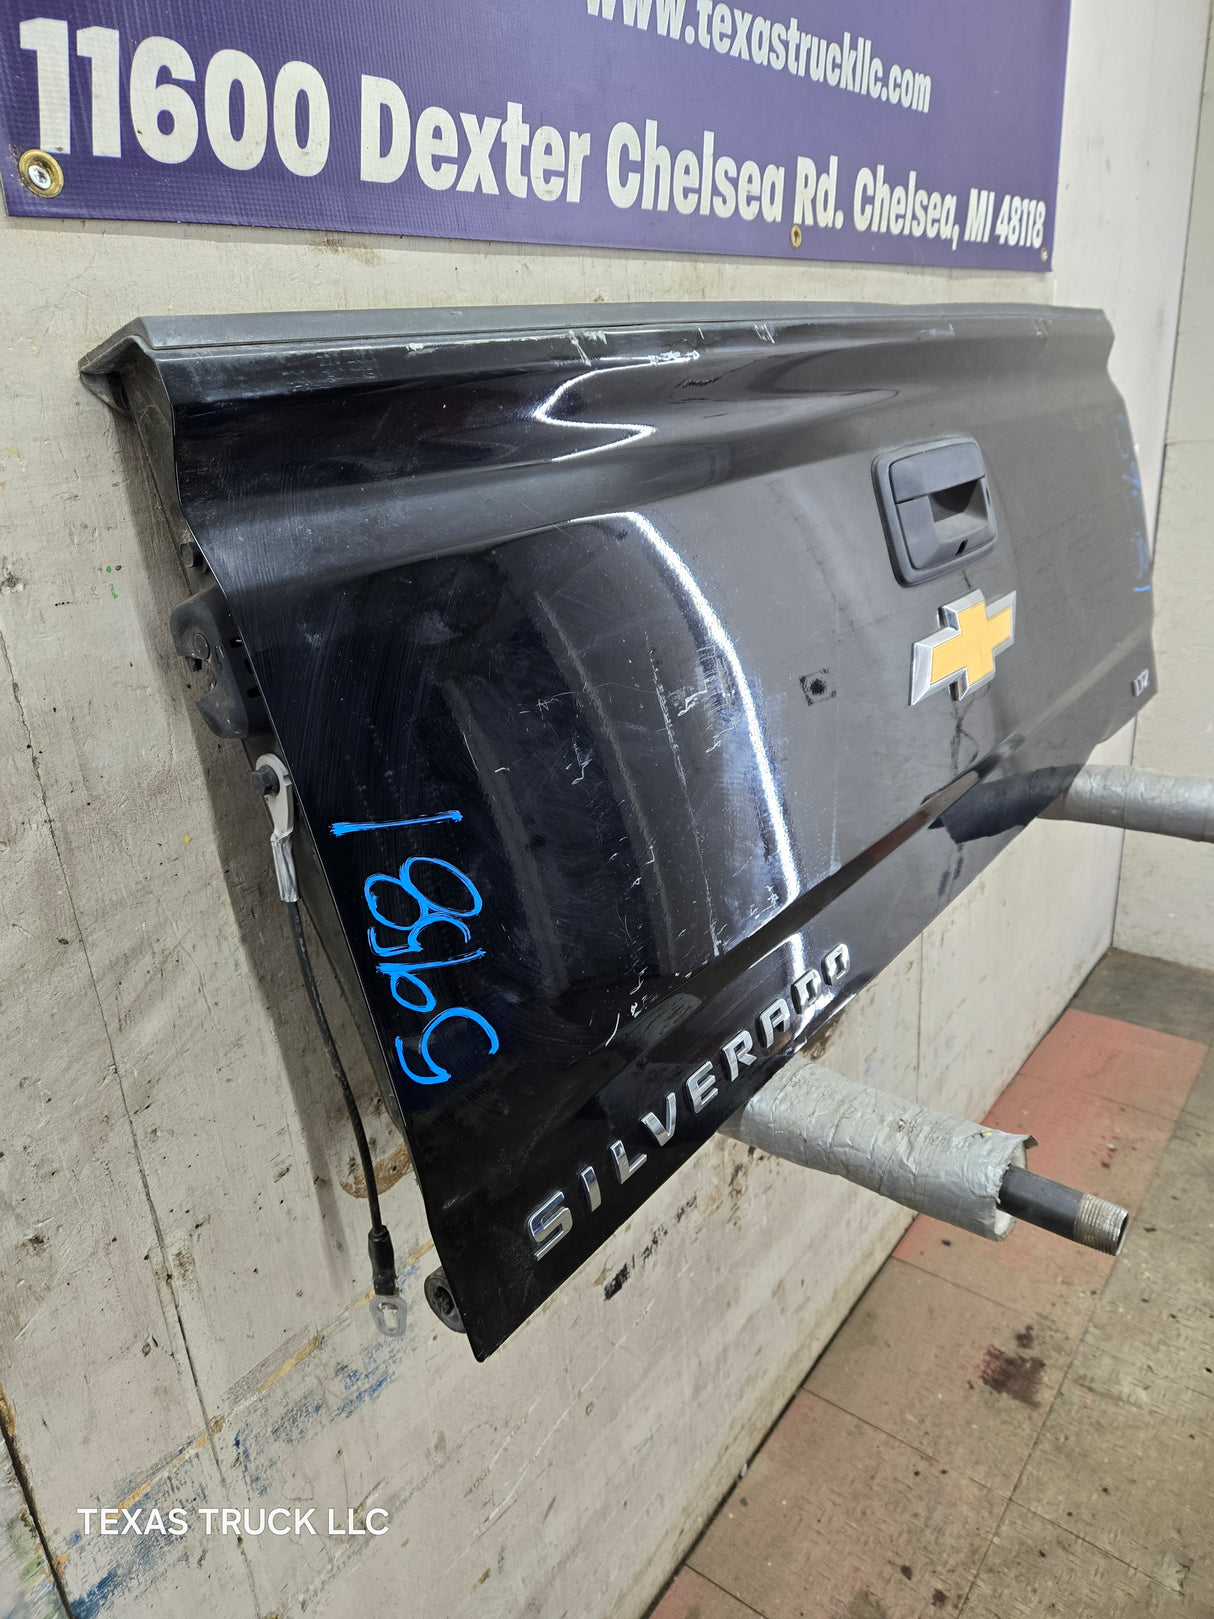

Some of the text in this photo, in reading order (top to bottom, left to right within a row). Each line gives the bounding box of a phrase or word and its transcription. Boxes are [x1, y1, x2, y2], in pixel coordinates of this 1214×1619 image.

[19, 17, 1047, 250] 11600 Dexter Chelsea Rd. Chelsea, MI 48118
[527, 943, 851, 1262] SILVERADO
